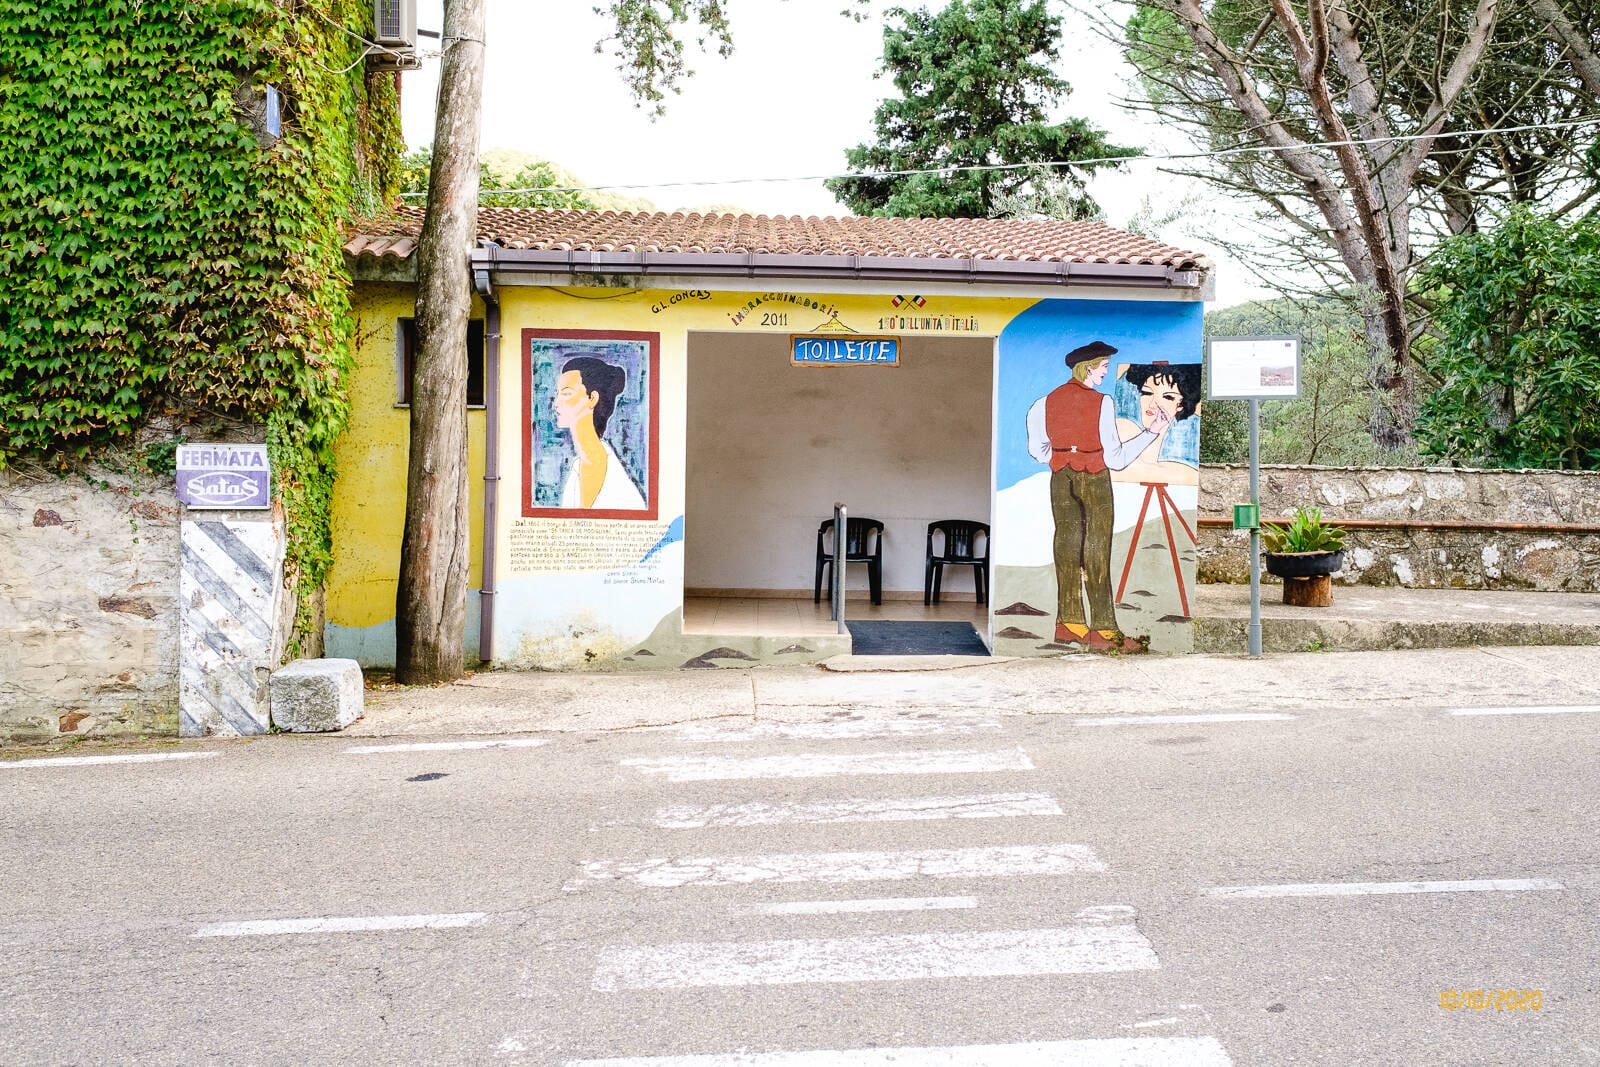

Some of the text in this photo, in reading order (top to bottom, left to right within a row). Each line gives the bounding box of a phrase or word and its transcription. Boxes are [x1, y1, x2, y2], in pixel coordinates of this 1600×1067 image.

[760, 312, 788, 326] 2011
[798, 339, 890, 361] TOILETTE
[181, 450, 263, 467] FERMATA
